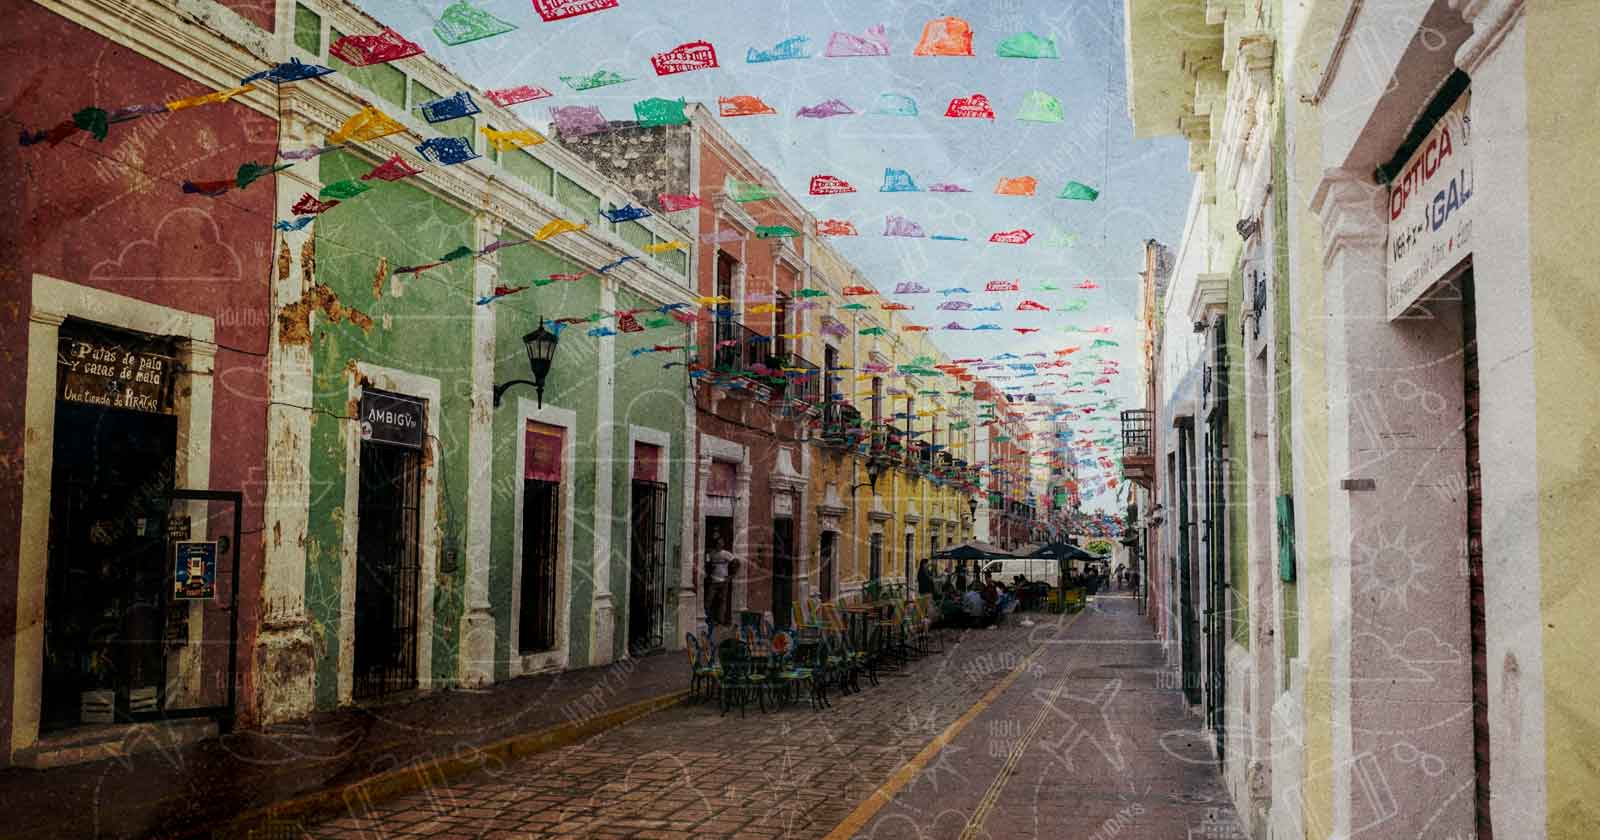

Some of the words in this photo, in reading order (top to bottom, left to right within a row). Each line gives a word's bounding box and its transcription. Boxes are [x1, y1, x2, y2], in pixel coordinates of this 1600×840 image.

[1391, 127, 1453, 221] OPTICA
[122, 352, 135, 366] de
[140, 357, 161, 372] palo
[120, 367, 132, 380] de
[136, 371, 160, 385] malo
